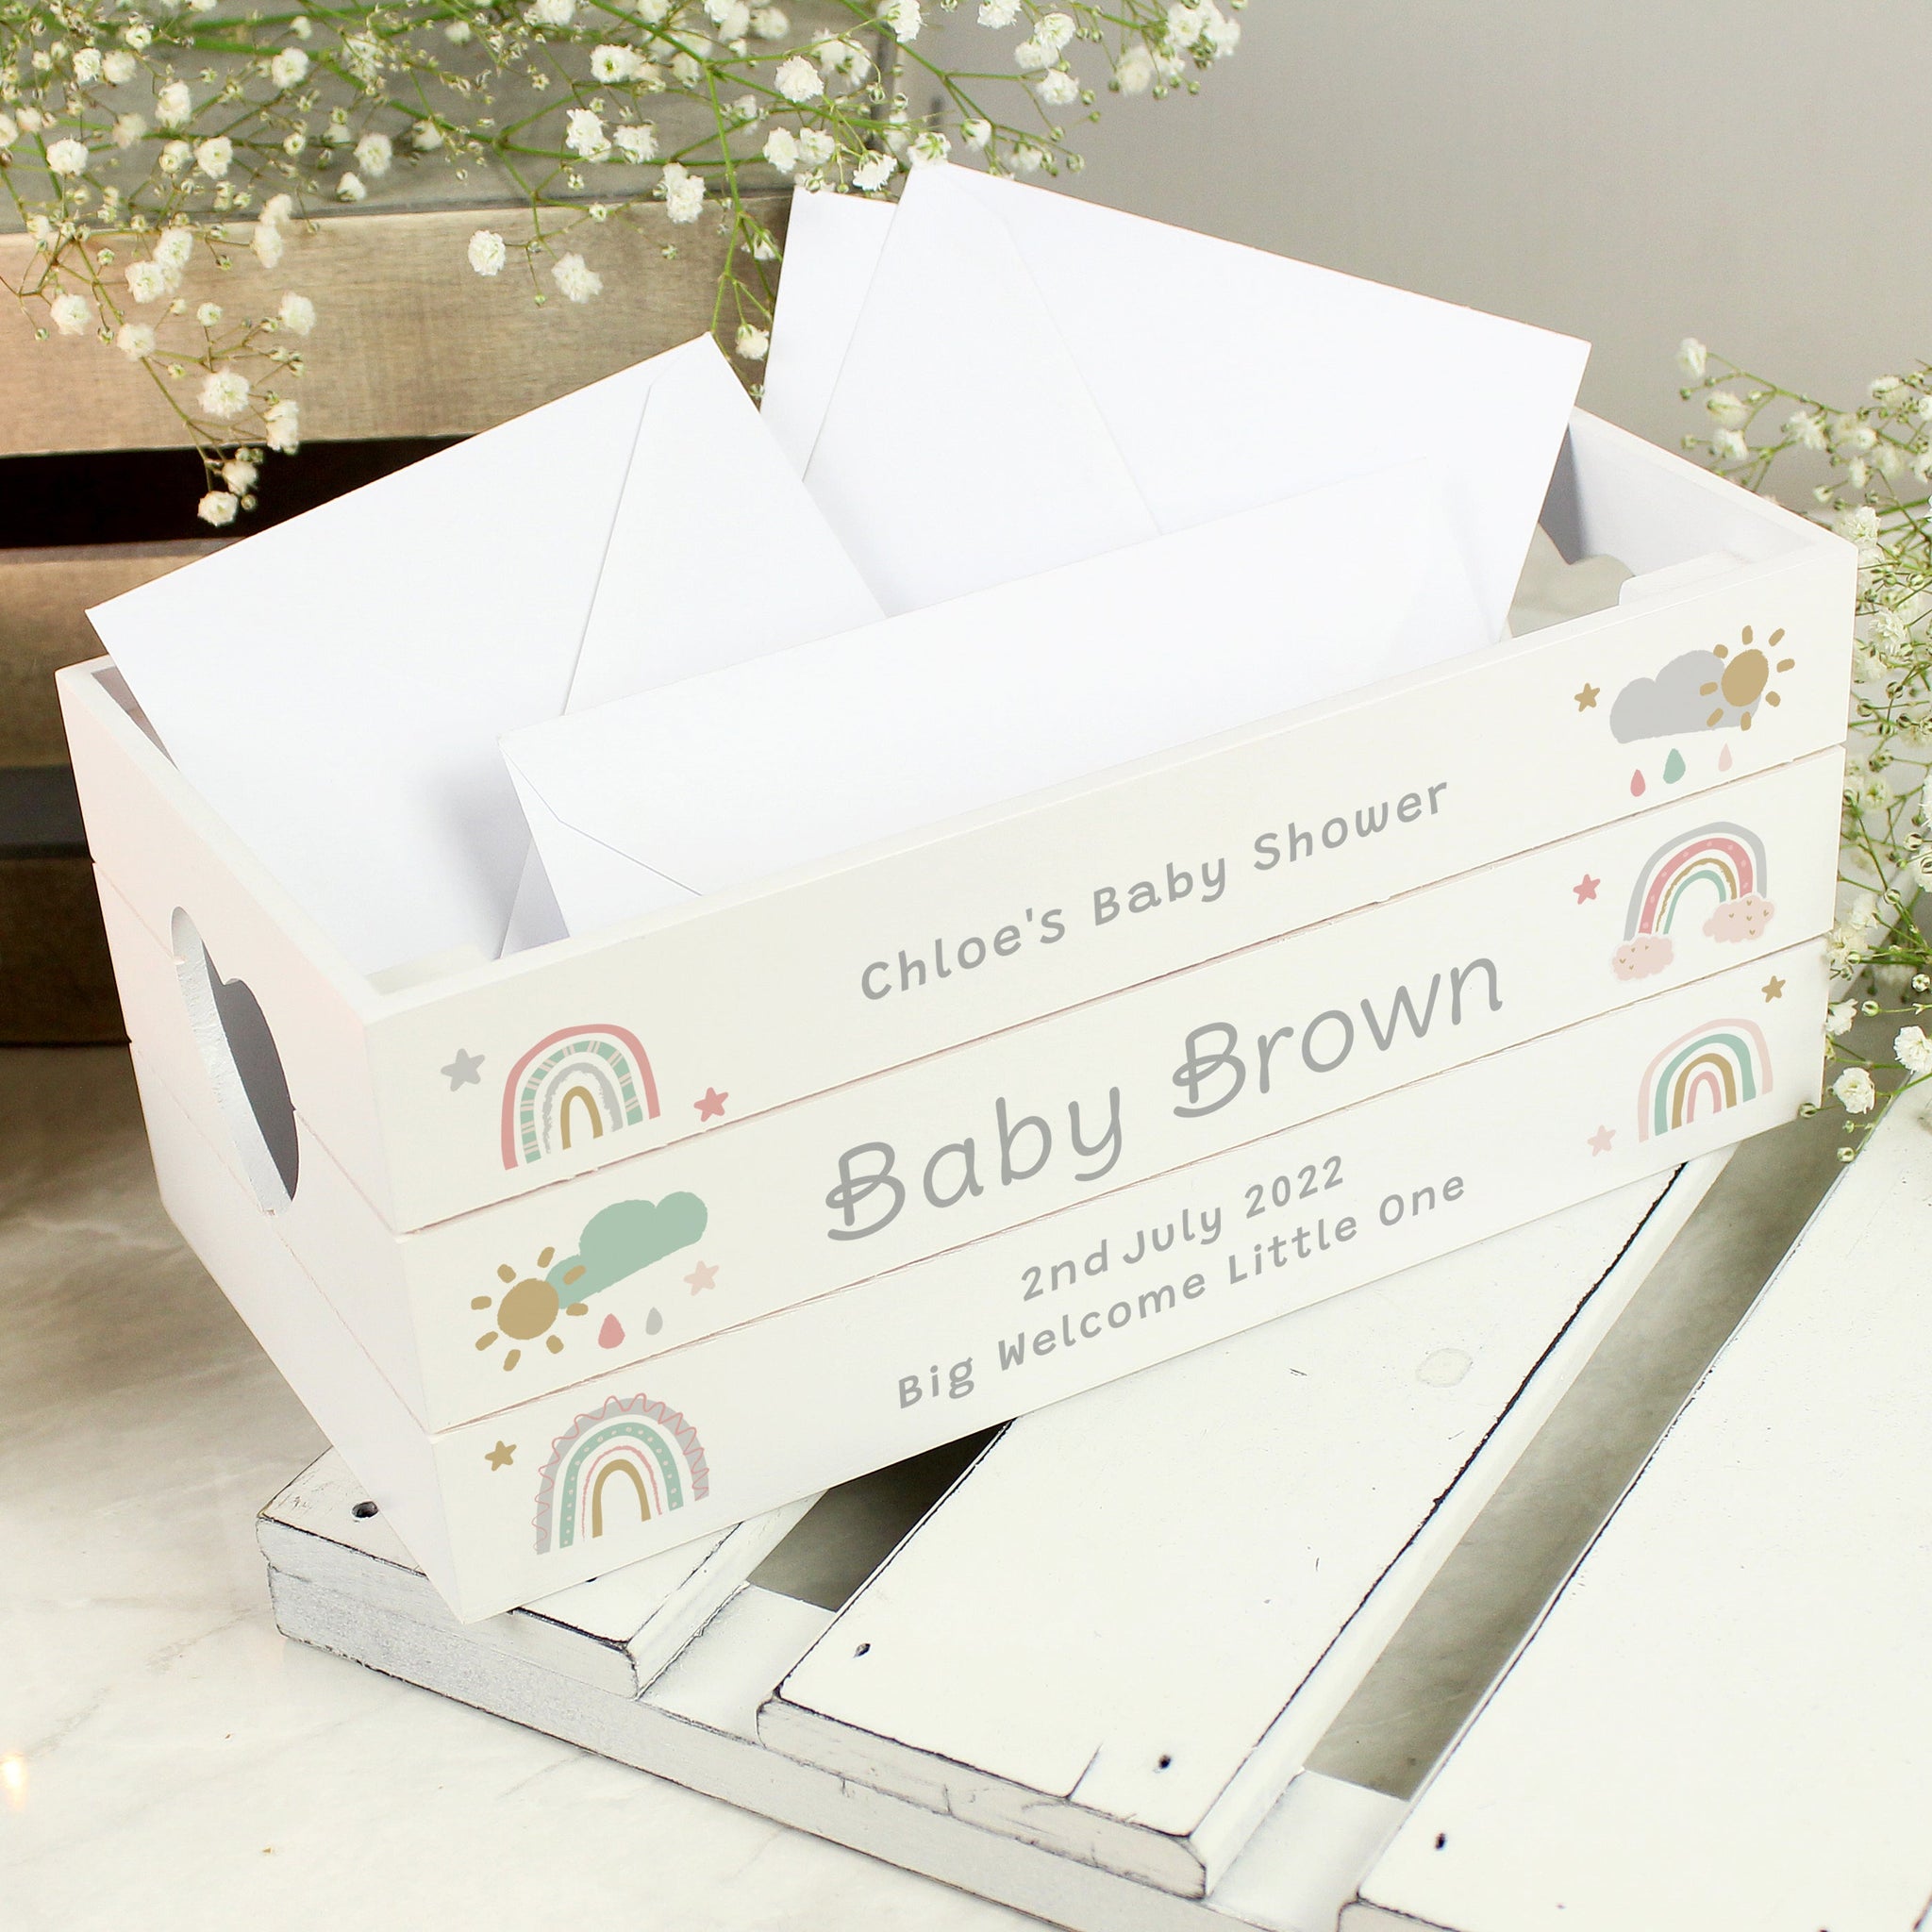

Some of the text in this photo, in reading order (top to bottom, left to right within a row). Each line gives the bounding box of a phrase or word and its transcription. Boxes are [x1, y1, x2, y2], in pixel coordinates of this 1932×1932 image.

[1093, 858, 1225, 926] Baby
[1254, 781, 1447, 871] Shower
[824, 958, 1503, 1241] Baby Brown
[898, 1175, 1464, 1409] Big Welcome Little One
[1021, 1155, 1343, 1302] 2nd July 2022
